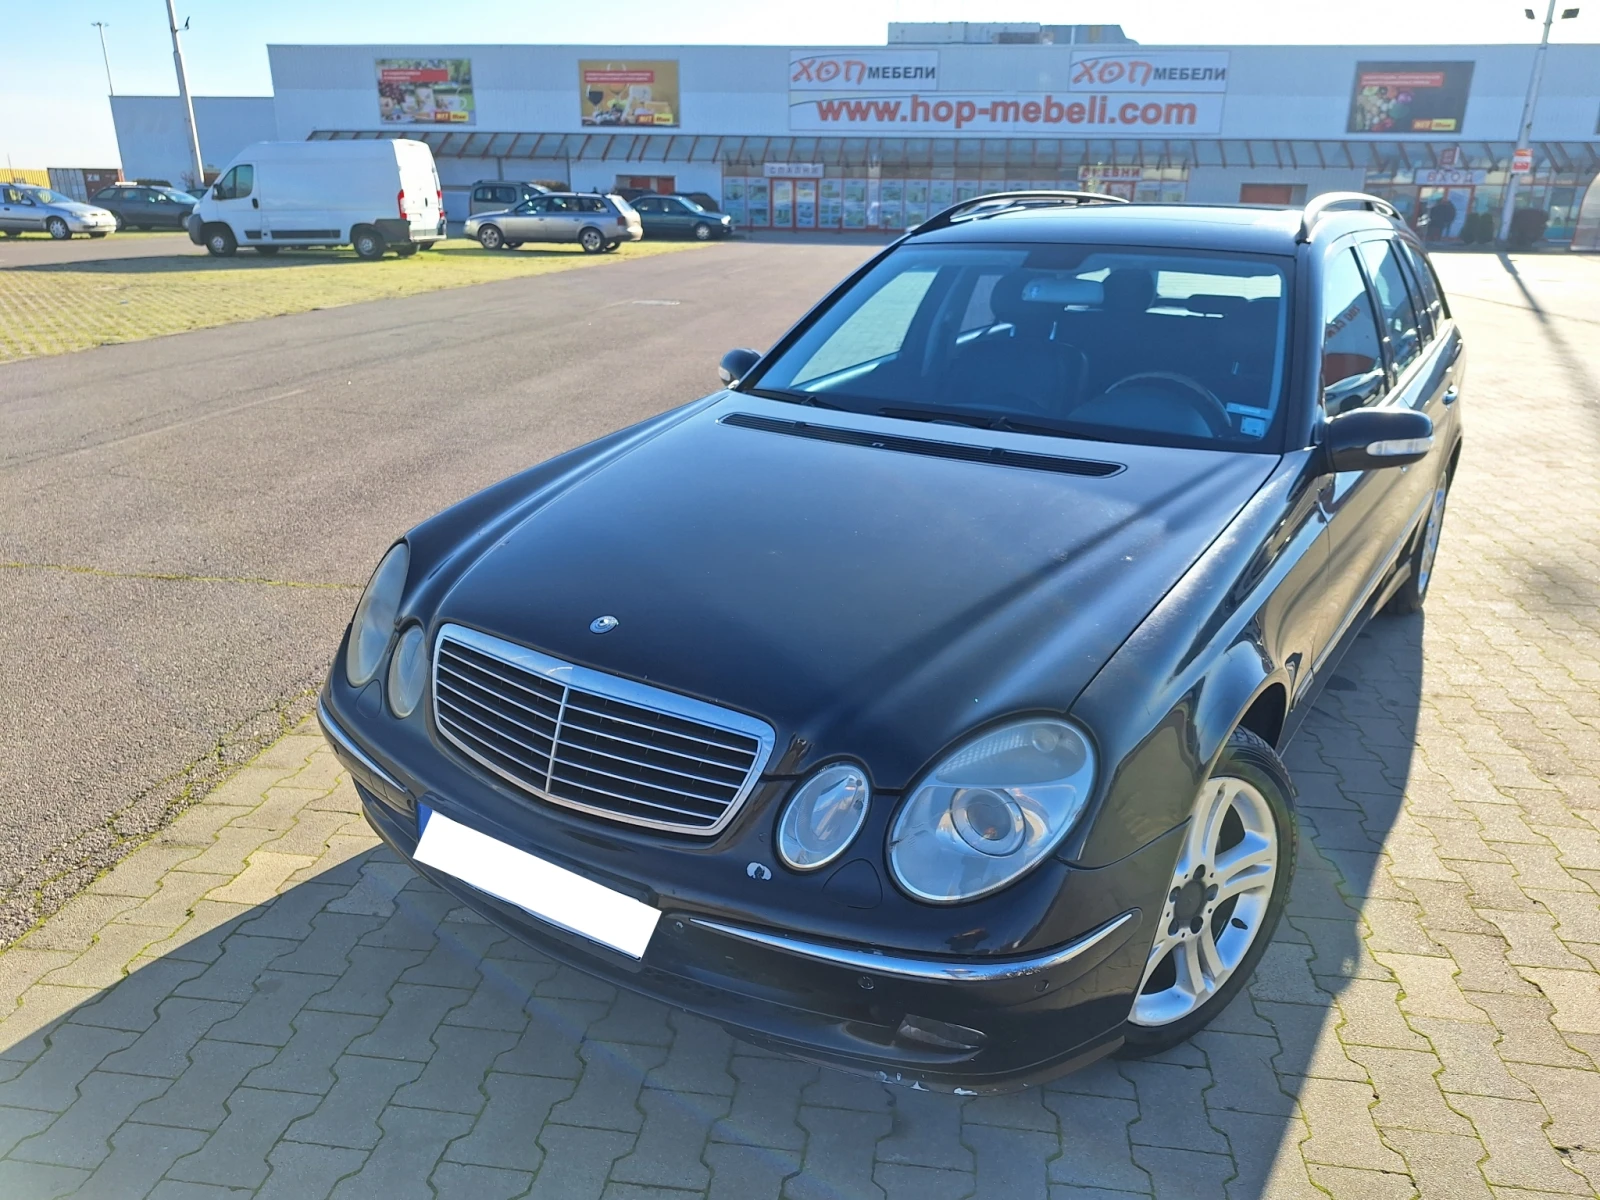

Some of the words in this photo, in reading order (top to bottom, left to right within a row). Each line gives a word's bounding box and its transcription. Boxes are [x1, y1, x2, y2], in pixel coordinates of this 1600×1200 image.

[867, 66, 936, 79] МЕБЕЛИ
[1153, 67, 1227, 80] МЕБЕЛИ
[816, 94, 1198, 128] www.hop-mebeli.com
